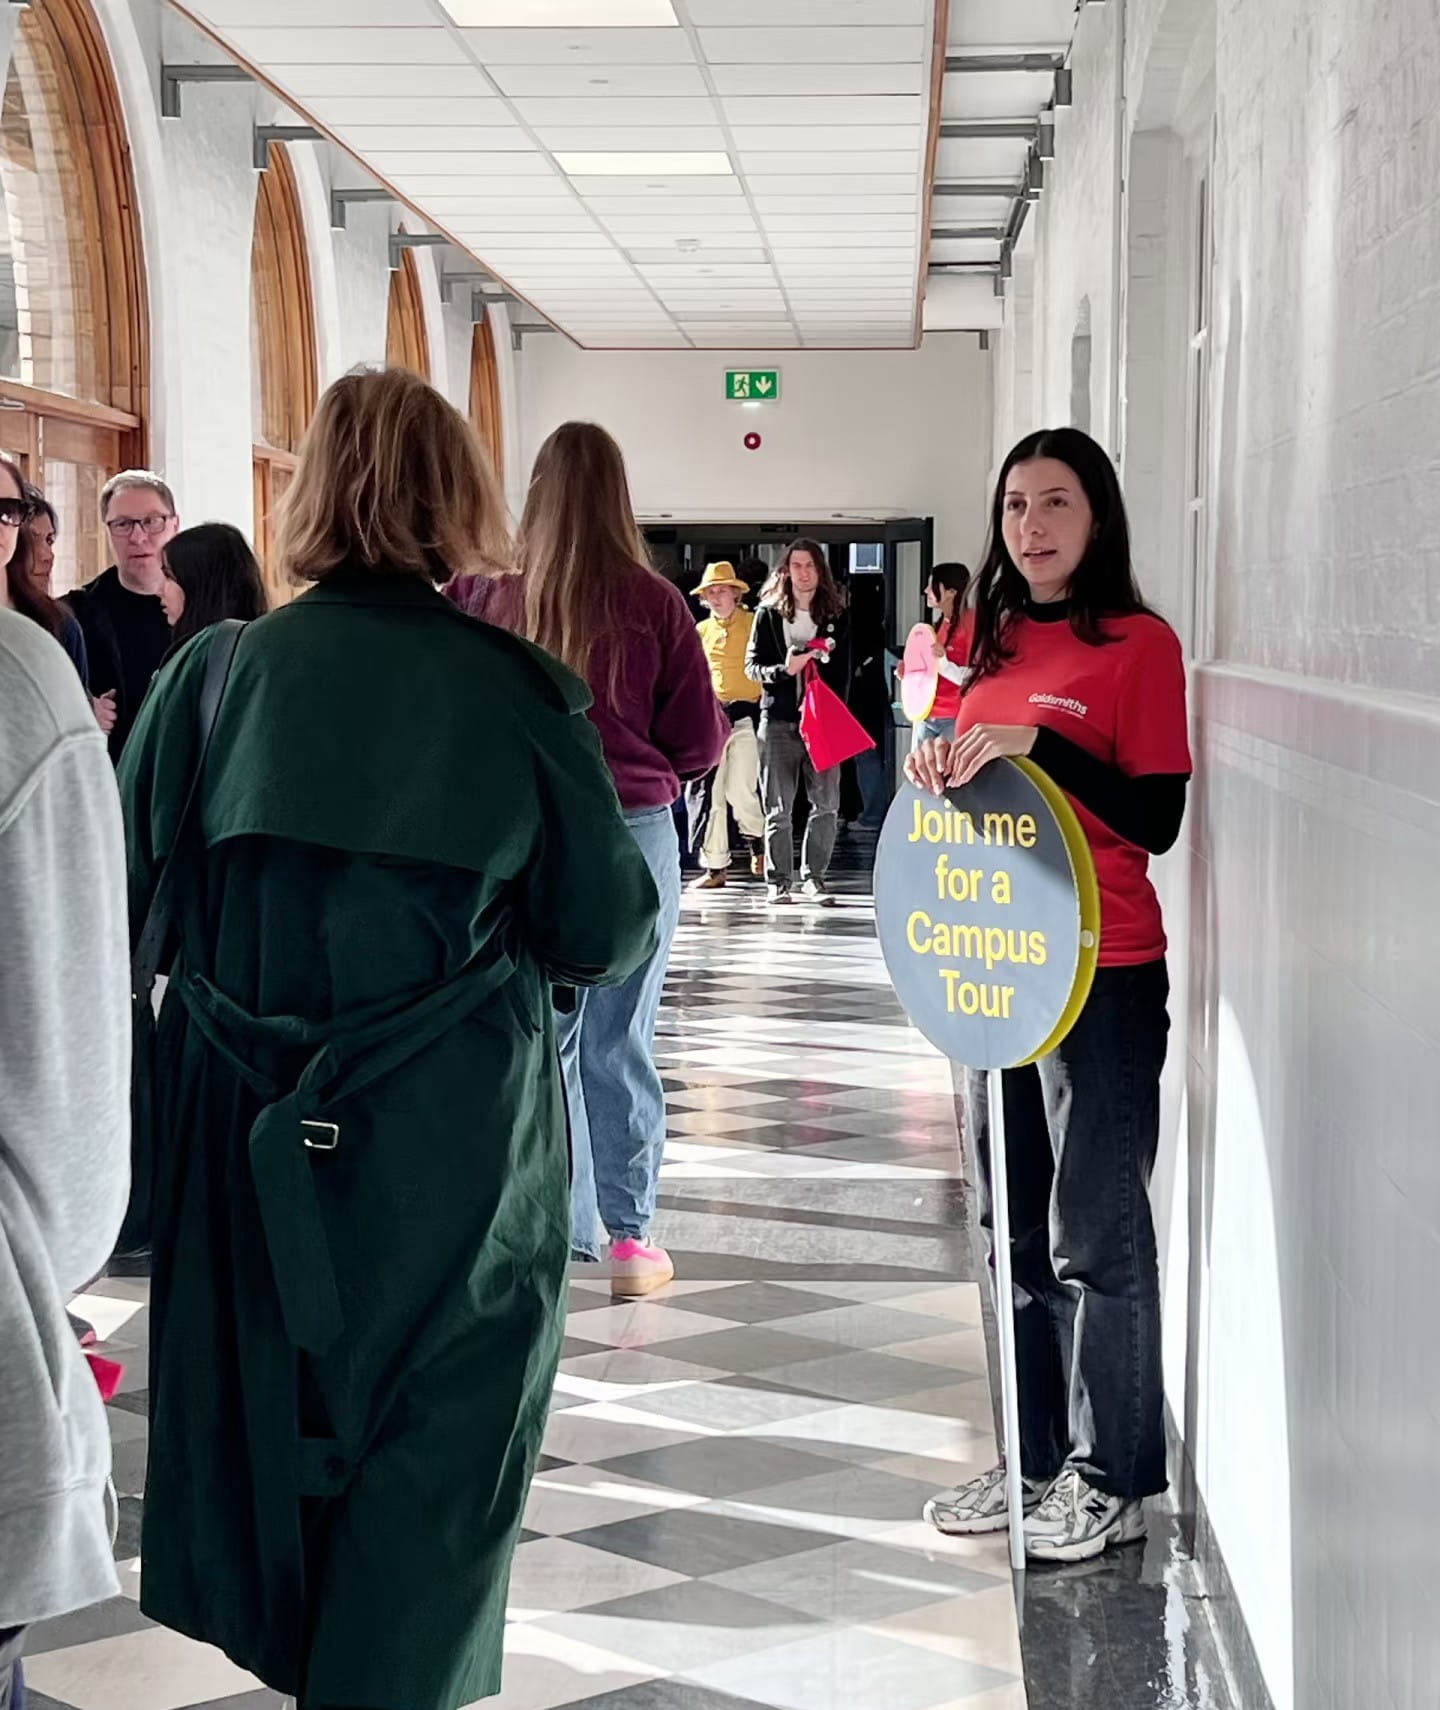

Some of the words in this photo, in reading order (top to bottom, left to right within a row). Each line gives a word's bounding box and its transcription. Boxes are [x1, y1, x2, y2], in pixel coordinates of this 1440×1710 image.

[1028, 692, 1088, 715] Goldsmiths
[908, 799, 974, 844] Join
[984, 813, 1037, 848] me
[935, 854, 983, 902] for
[991, 871, 1011, 904] a
[907, 911, 1046, 970] Campus
[939, 970, 1014, 1019] Tour
